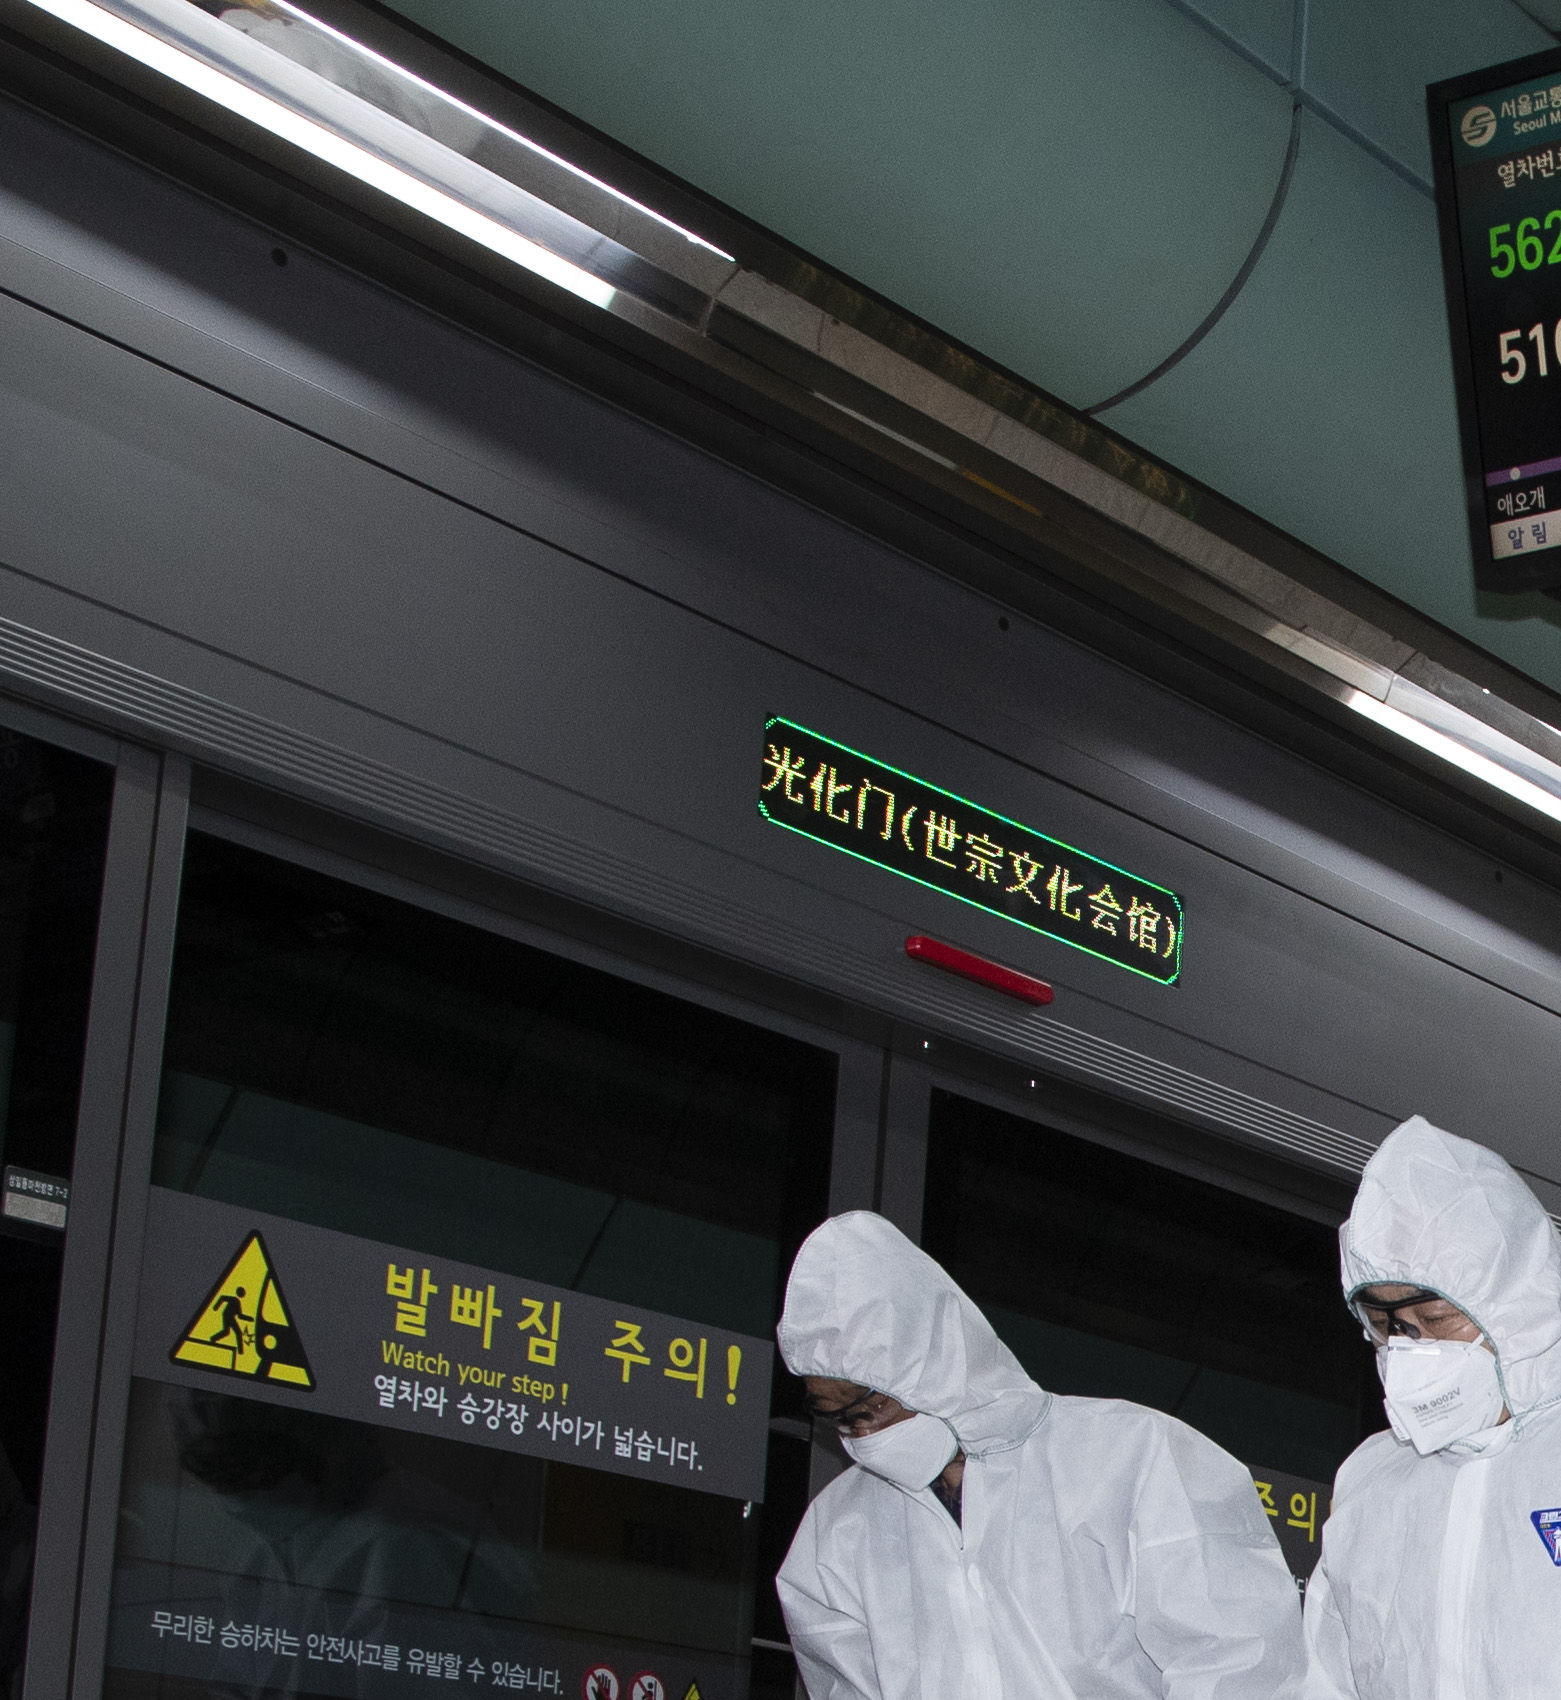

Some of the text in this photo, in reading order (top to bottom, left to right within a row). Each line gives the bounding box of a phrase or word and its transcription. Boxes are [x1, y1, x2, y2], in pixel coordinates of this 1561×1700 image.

[1513, 115, 1547, 135] Seoul
[1497, 486, 1546, 516] 애오개
[762, 744, 1177, 958] 光化门(世宗文化会馆)
[385, 1263, 562, 1367] 발빠짐
[381, 1340, 450, 1377] Watch
[457, 1353, 506, 1391] your
[373, 1374, 704, 1472] 열차와 승강장 사이가 넓습니다.
[150, 1610, 564, 1696] 무리한 승하차는 안전사고를 유발할 수 있습니다.
